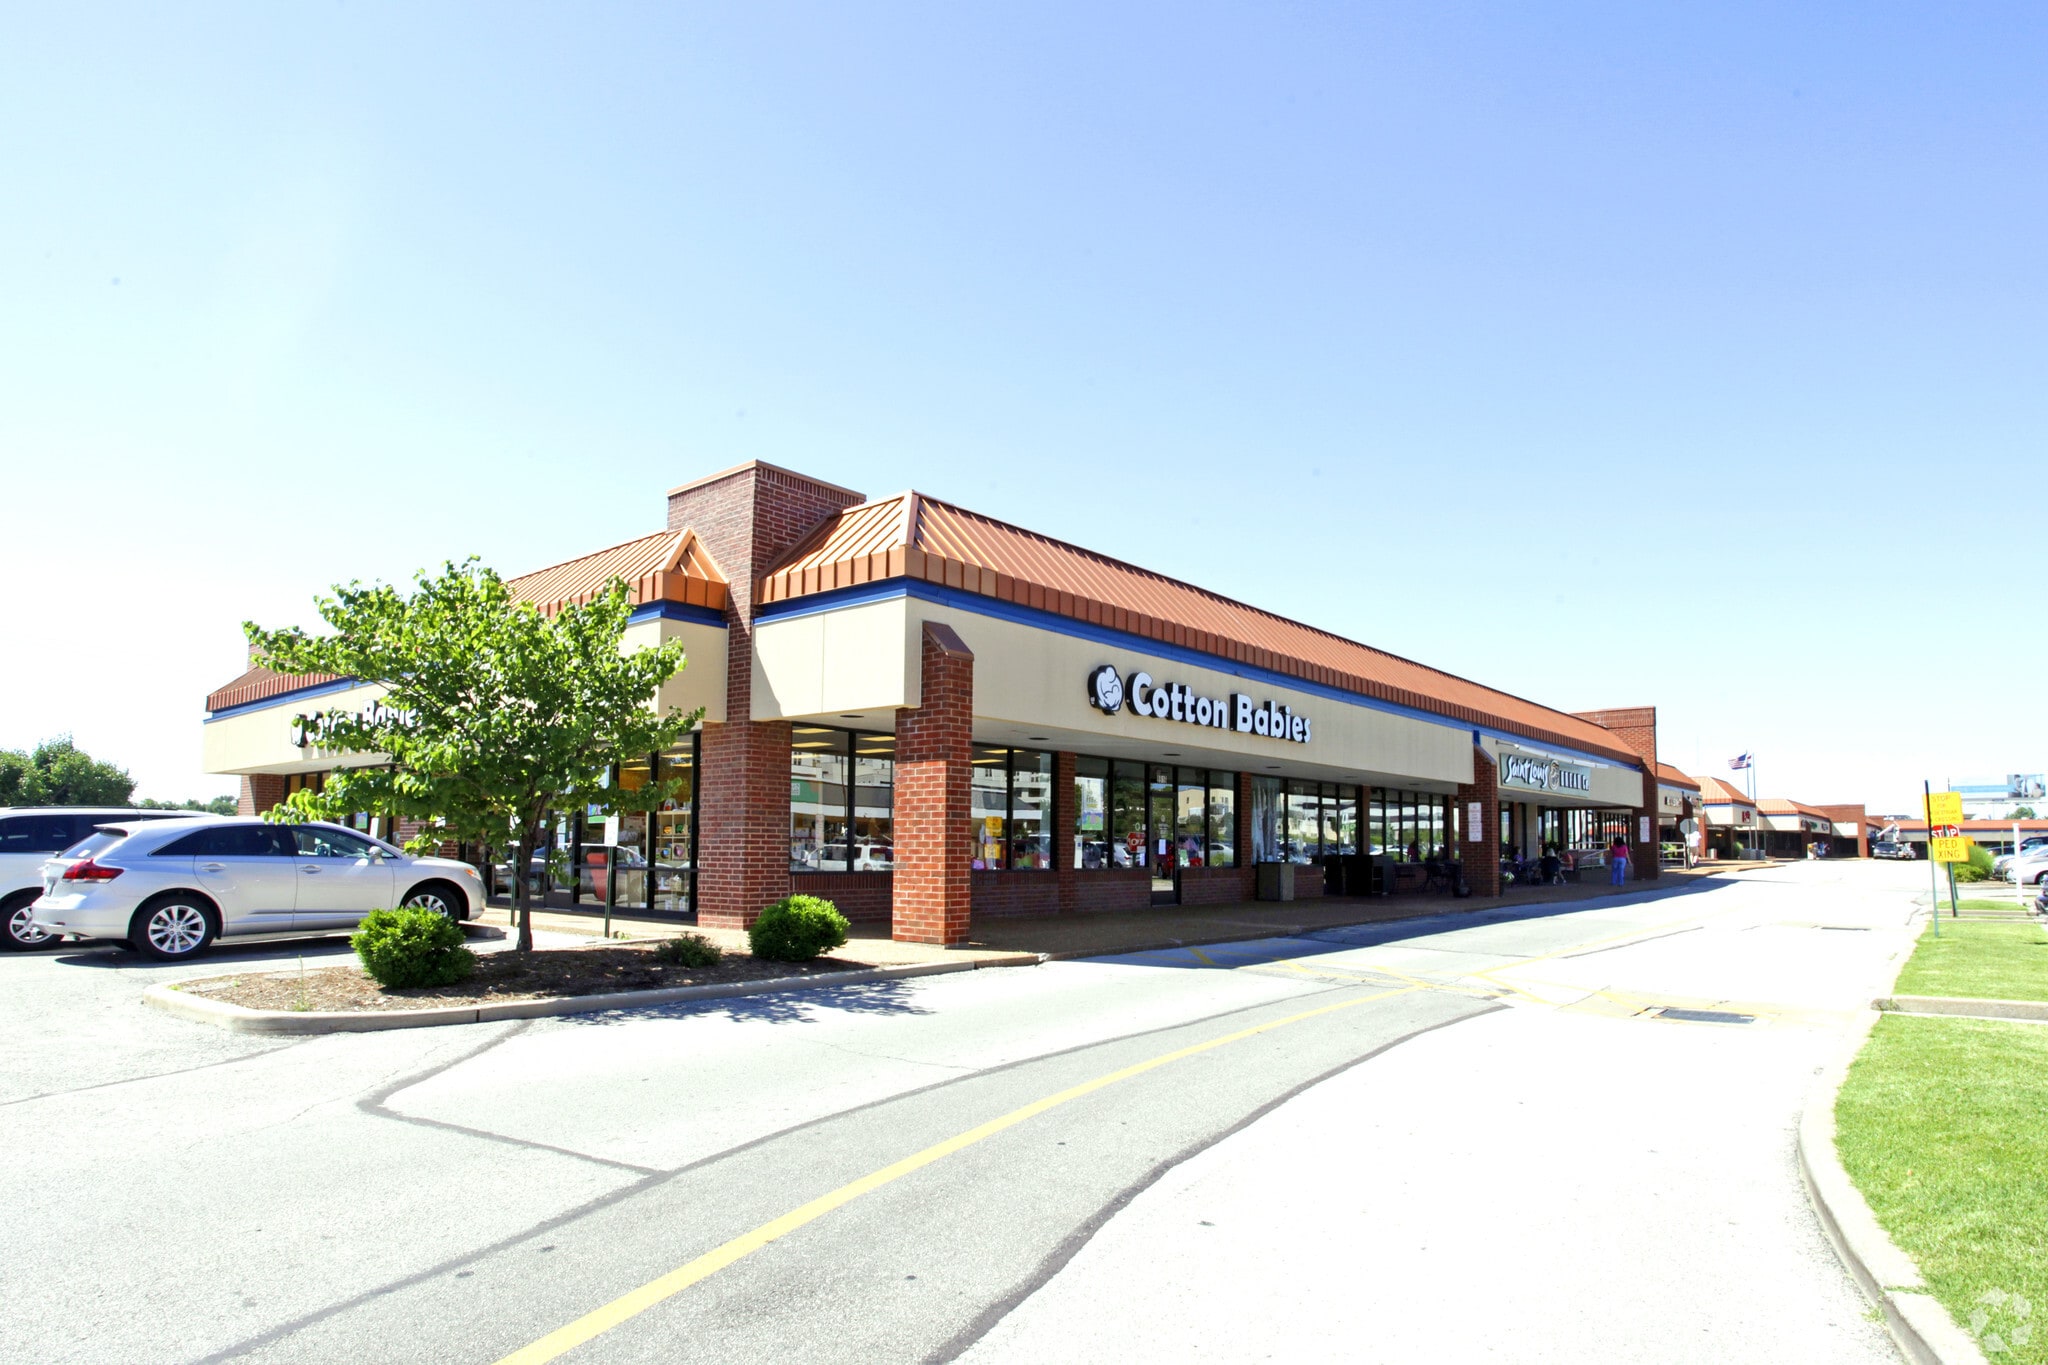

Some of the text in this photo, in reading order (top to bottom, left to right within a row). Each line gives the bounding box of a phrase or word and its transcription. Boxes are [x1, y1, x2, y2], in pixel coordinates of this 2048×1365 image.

[1127, 671, 1312, 743] Cotton Babies
[1938, 839, 1958, 849] PED
[1938, 849, 1960, 859] XING
